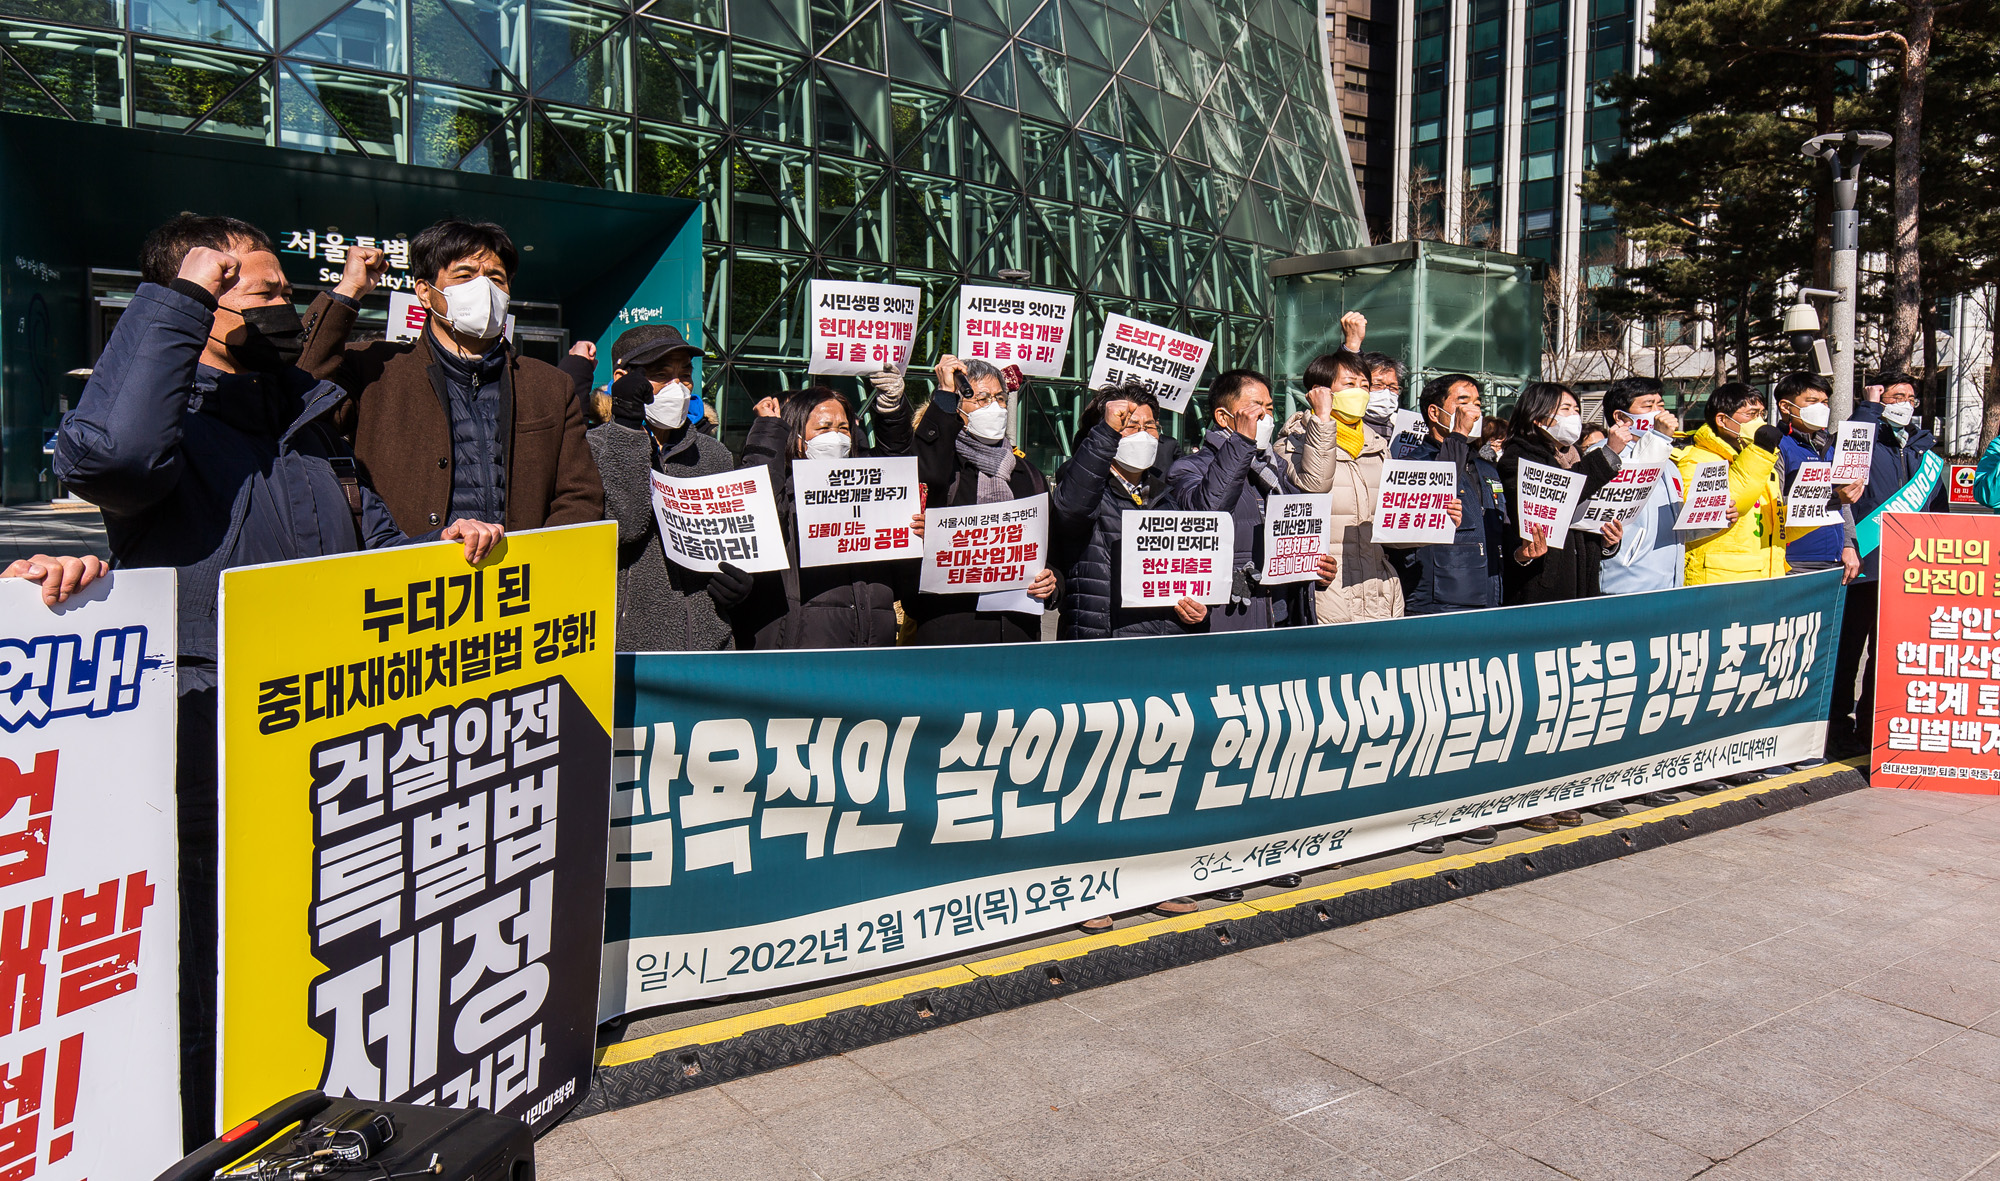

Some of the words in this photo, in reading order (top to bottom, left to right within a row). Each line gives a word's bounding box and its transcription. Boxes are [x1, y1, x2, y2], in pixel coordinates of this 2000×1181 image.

[819, 293, 880, 312] 시민생명
[883, 296, 915, 315] 앗아간
[968, 297, 1025, 315] 시민생명
[1028, 302, 1066, 320] 앗아간
[818, 317, 913, 341] 현대산업개발
[966, 319, 1064, 343] 현대산업개발
[1116, 323, 1165, 352] 돈보다
[1168, 338, 1203, 363] 생명!
[1106, 342, 1195, 383] 현대산업개발
[828, 468, 882, 486] 살인기업
[1386, 471, 1427, 486] 시민생명
[1429, 472, 1453, 486] 앗아간
[1523, 466, 1544, 482] 시민의
[1544, 472, 1571, 489] 생명과
[1801, 468, 1823, 482] 돈보다
[678, 487, 714, 501] 생명과
[717, 480, 757, 499] 안전을
[804, 489, 872, 505] 현대산업개발
[874, 486, 907, 501] 봐주기
[1382, 491, 1453, 509] 현대산업개발
[1522, 481, 1539, 497] 안전이
[1539, 487, 1567, 503] 먼저다!
[1707, 495, 1727, 507] 퇴출로
[705, 499, 745, 514] 짓밟은
[937, 516, 977, 528] 서울시에
[980, 514, 999, 526] 강력
[1002, 507, 1038, 522] 촉구한다!
[1284, 503, 1312, 518] 살인기업
[1533, 503, 1558, 520] 퇴출로
[808, 522, 841, 539] 되풀이
[844, 521, 866, 536] 되는
[952, 523, 1024, 548] 살인기업
[1138, 517, 1178, 532] 시민의
[1180, 517, 1218, 533] 생명과
[1273, 518, 1323, 537] 현대산업개발
[668, 528, 759, 561] 퇴출하라!
[838, 537, 870, 553] 참사의
[874, 527, 909, 550] 공범
[1136, 535, 1174, 551] 안전이
[1177, 535, 1219, 551] 먼저다!
[1907, 537, 1990, 565] 시민의
[935, 542, 1039, 568] 현대산업개발
[1142, 558, 1169, 575] 현산
[1170, 557, 1212, 574] 퇴출로
[947, 564, 1025, 585] 퇴출하라!
[1903, 567, 1985, 597] 안전이
[363, 571, 484, 643] 누더기
[497, 563, 531, 619] 된
[258, 625, 523, 735] 중대재해처벌법
[533, 610, 596, 665] 강화!
[1906, 680, 1969, 716] 업계
[929, 692, 1195, 844] 살인기업
[1194, 653, 1524, 811] 현대산업개발의
[1524, 640, 1638, 755] 퇴출을
[1639, 629, 1710, 734] 강력
[1705, 611, 1822, 719] 촉구한다!
[317, 683, 560, 837] 건설안전
[1547, 775, 1592, 802] 퇴출을
[1590, 771, 1622, 793] 위한
[1620, 762, 1650, 783] 학동,
[1652, 757, 1691, 779] 화정동
[1692, 748, 1718, 772] 참사
[1719, 735, 1779, 767] 시민대책위
[1881, 762, 1937, 778] 현대산업개발
[1938, 764, 1958, 779] 퇴출
[1959, 765, 1969, 779] 및
[1328, 826, 1352, 852] 앞
[316, 764, 559, 946] 특별법
[857, 910, 904, 955] 2월
[912, 887, 1018, 939] 17일(목)
[1024, 875, 1074, 916] 오후
[1080, 866, 1119, 902] 2시
[315, 869, 555, 1103] 제정
